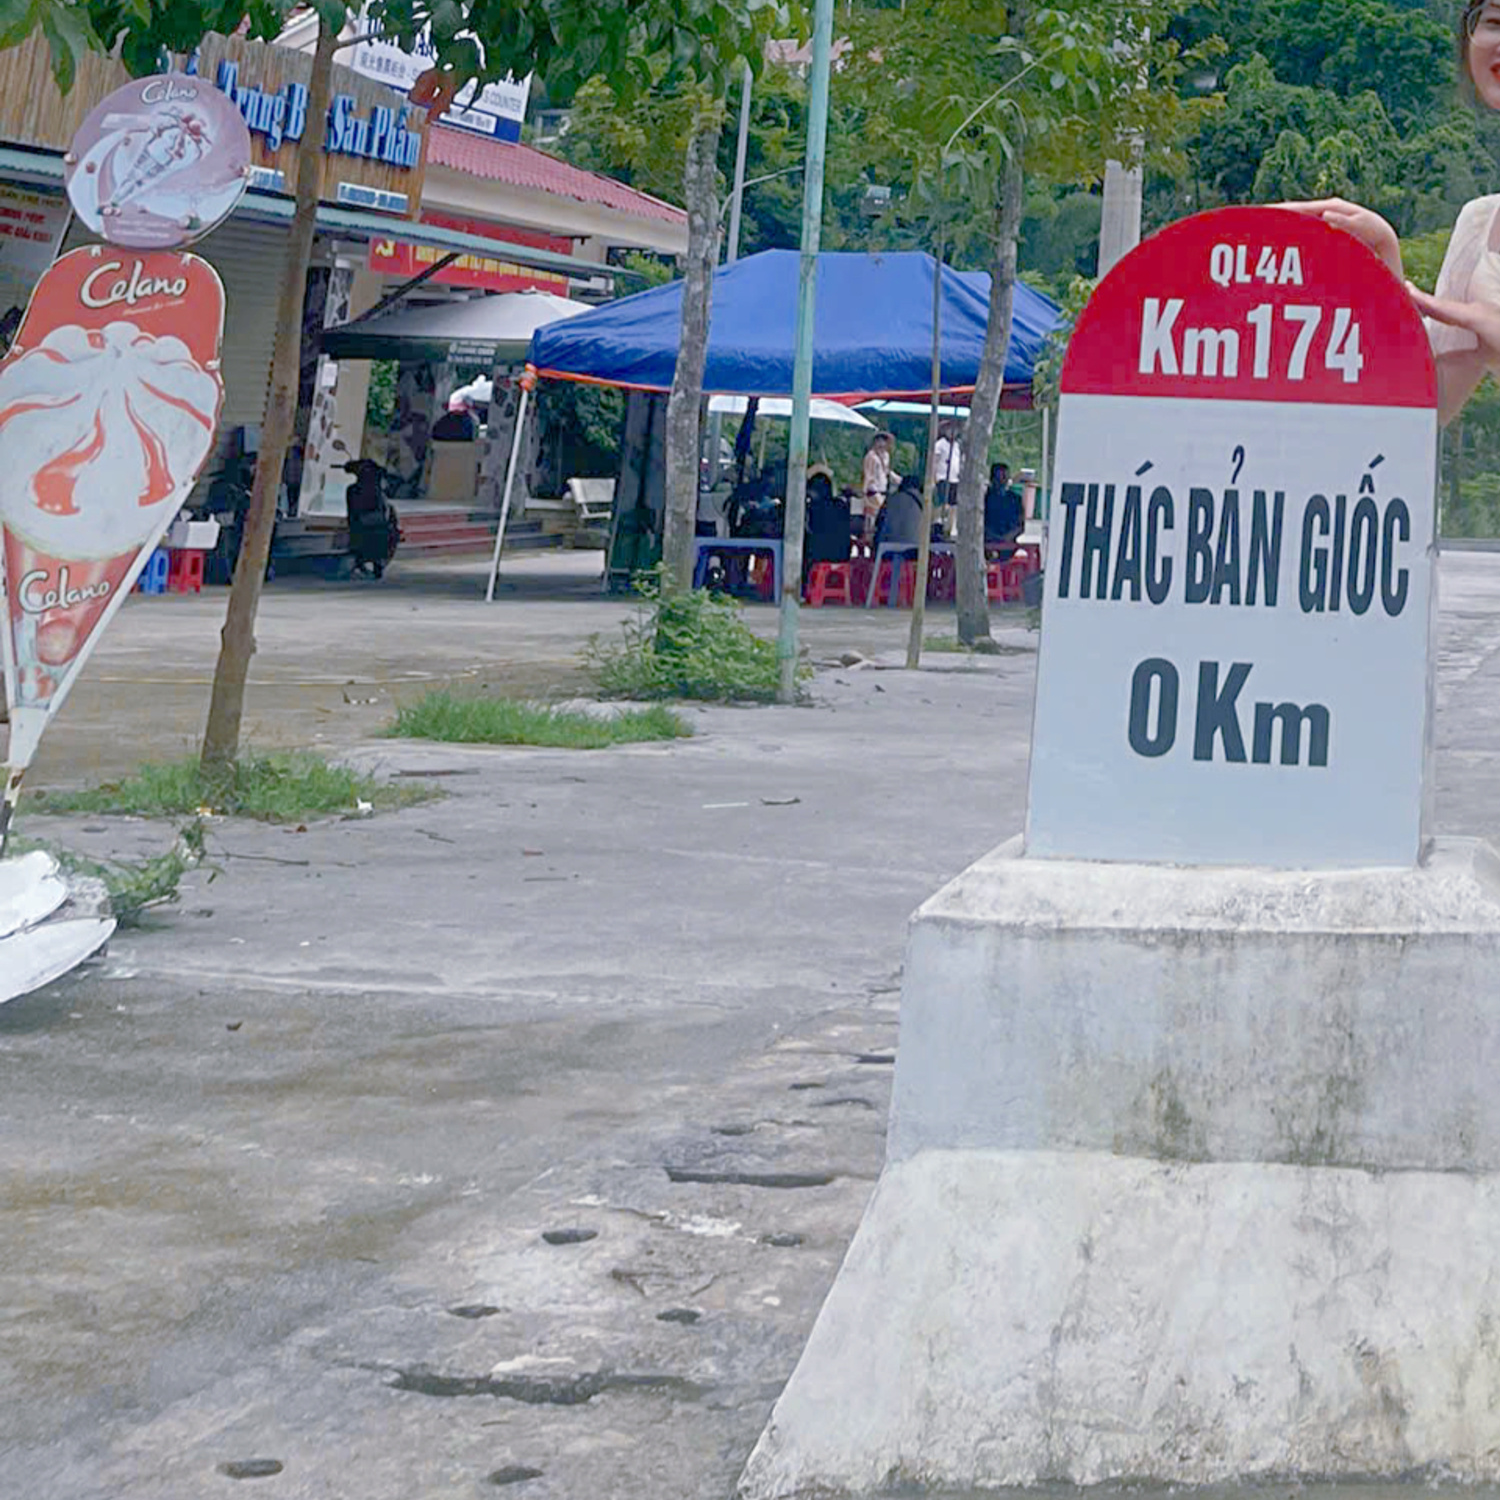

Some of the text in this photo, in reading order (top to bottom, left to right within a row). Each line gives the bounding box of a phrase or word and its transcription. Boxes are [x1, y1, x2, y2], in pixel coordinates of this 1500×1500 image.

[141, 80, 199, 105] Celano
[80, 259, 188, 308] Celano
[1209, 243, 1303, 286] QL4A
[1137, 296, 1364, 384] Km174
[1056, 444, 1411, 618] THÁC BẢN GIỐC
[18, 566, 111, 614] Celano
[1127, 657, 1330, 768] 0 Km
